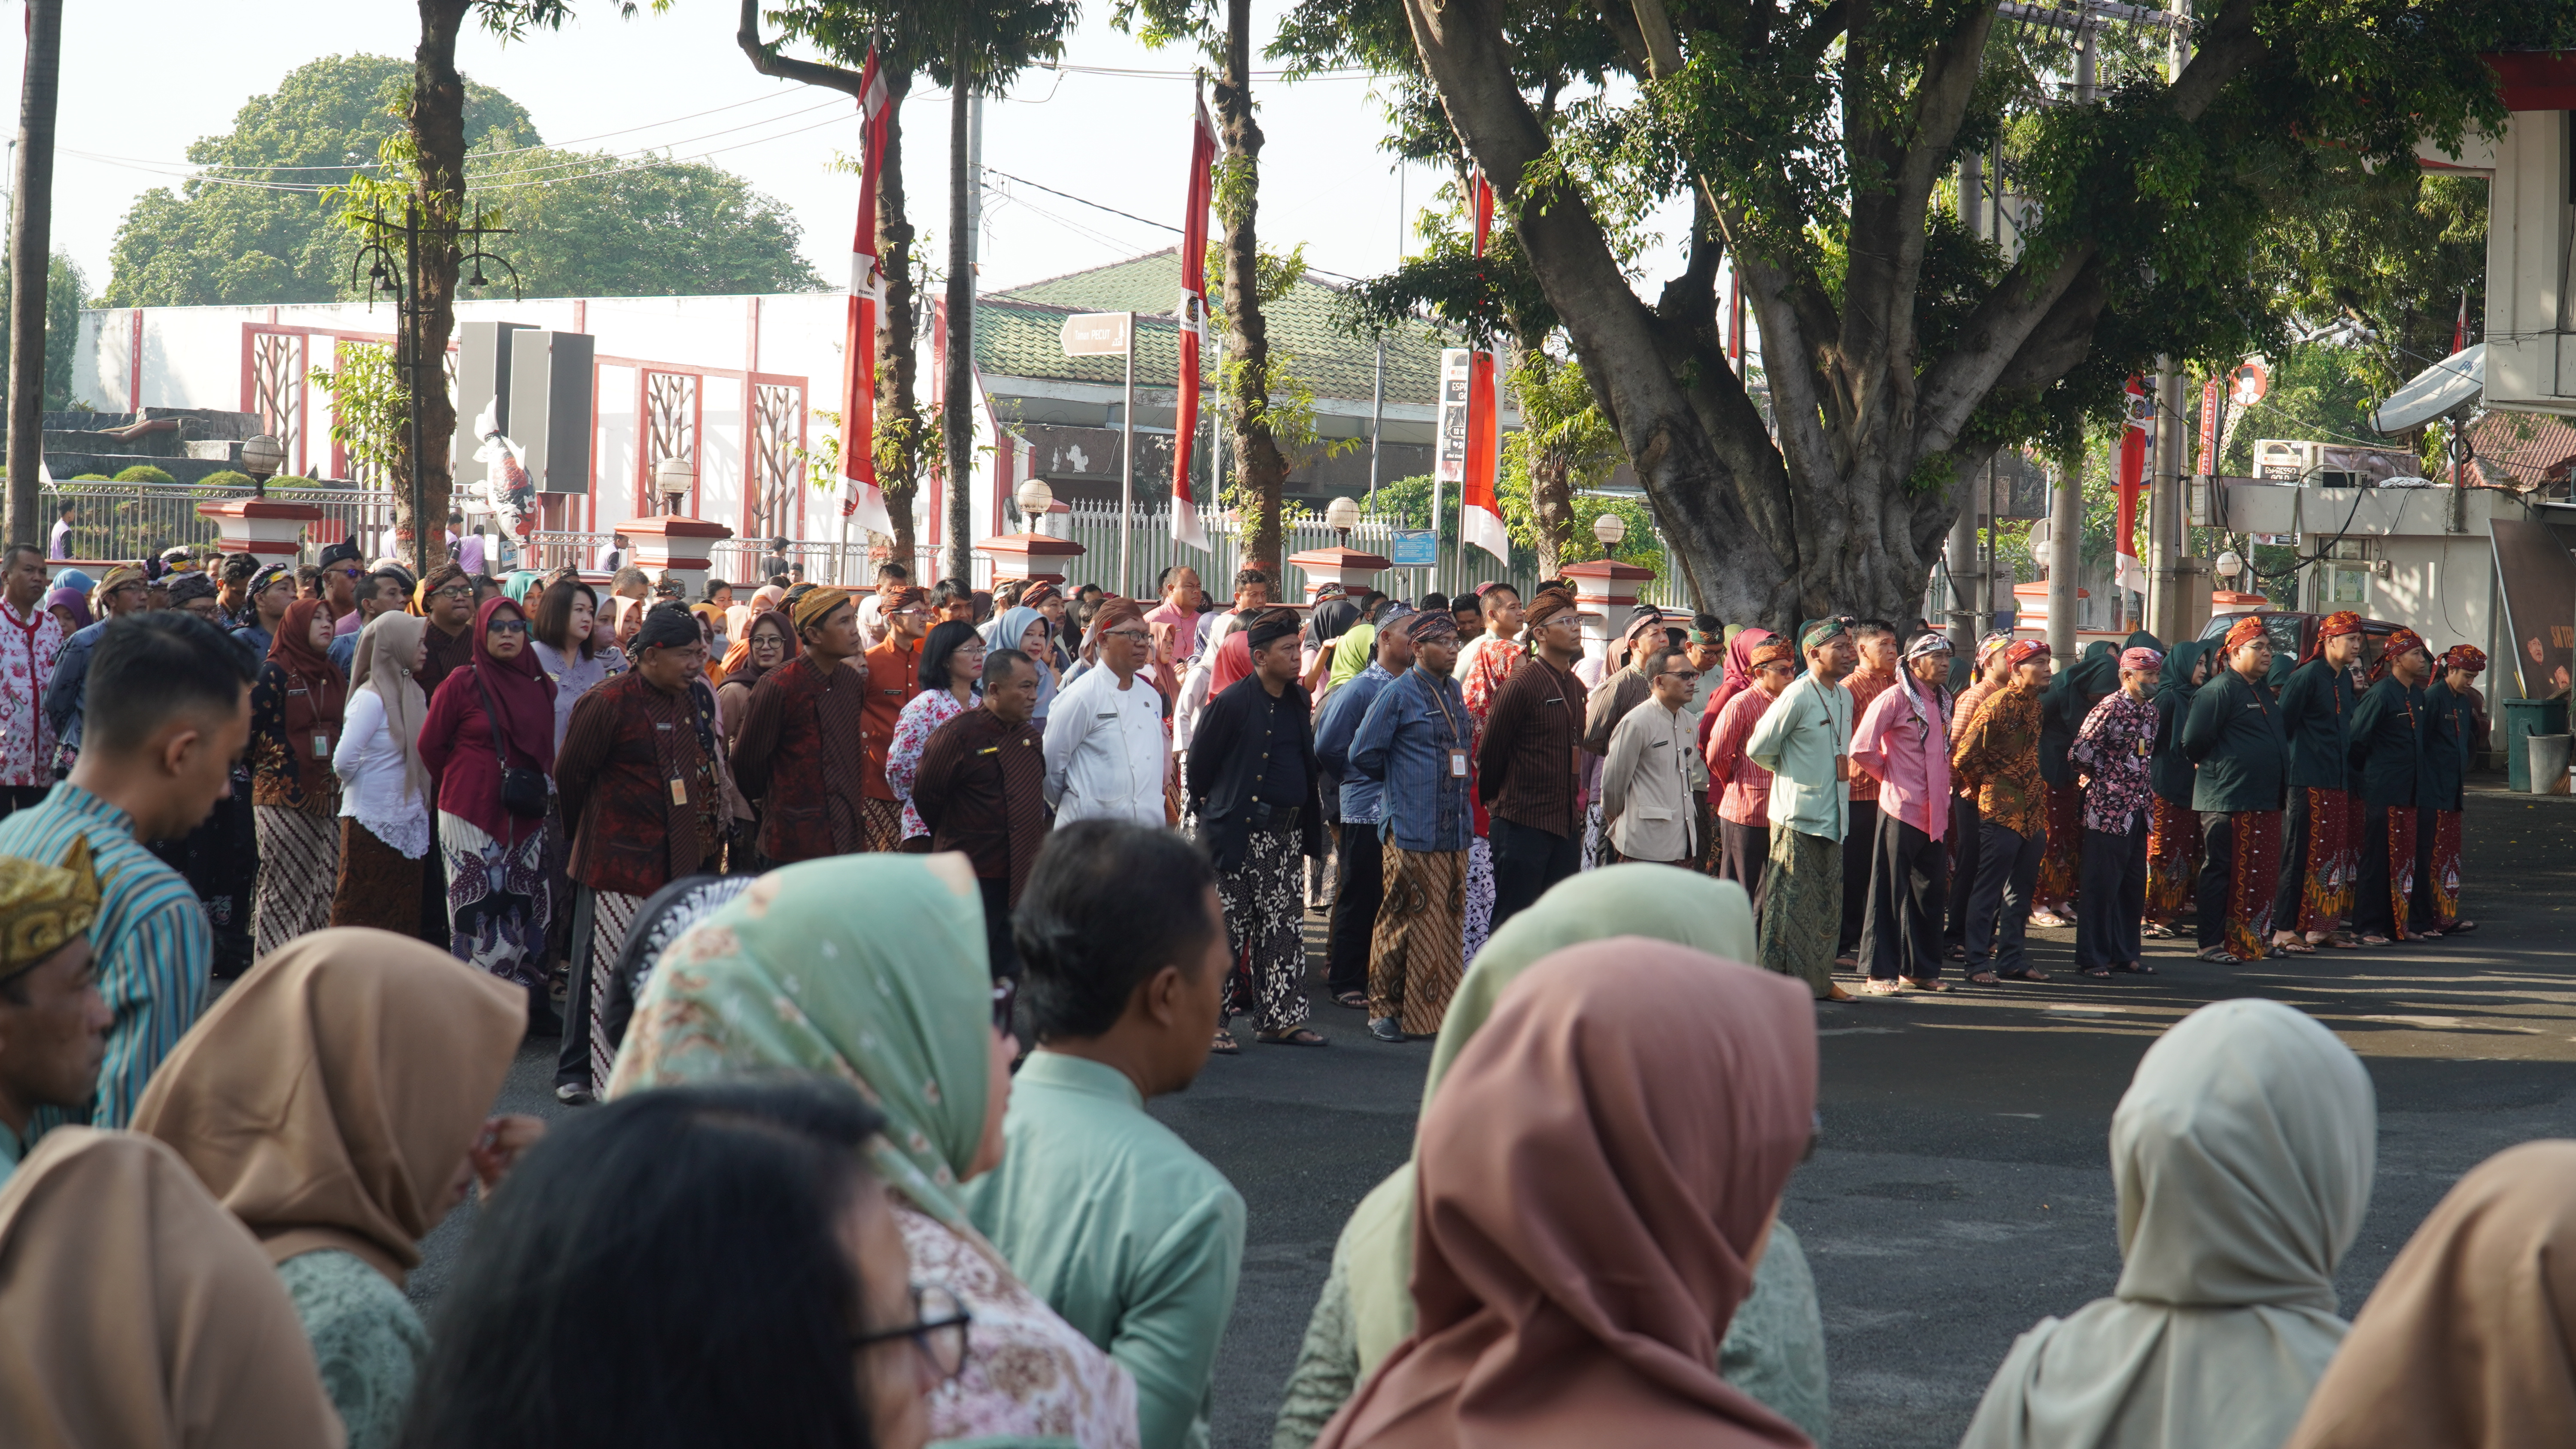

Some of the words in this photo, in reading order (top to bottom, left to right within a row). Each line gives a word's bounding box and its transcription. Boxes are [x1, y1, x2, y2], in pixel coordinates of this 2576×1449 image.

[1075, 330, 1089, 340] Taman
[1091, 329, 1110, 340] PECUT
[2265, 467, 2296, 475] ESPRESSO
